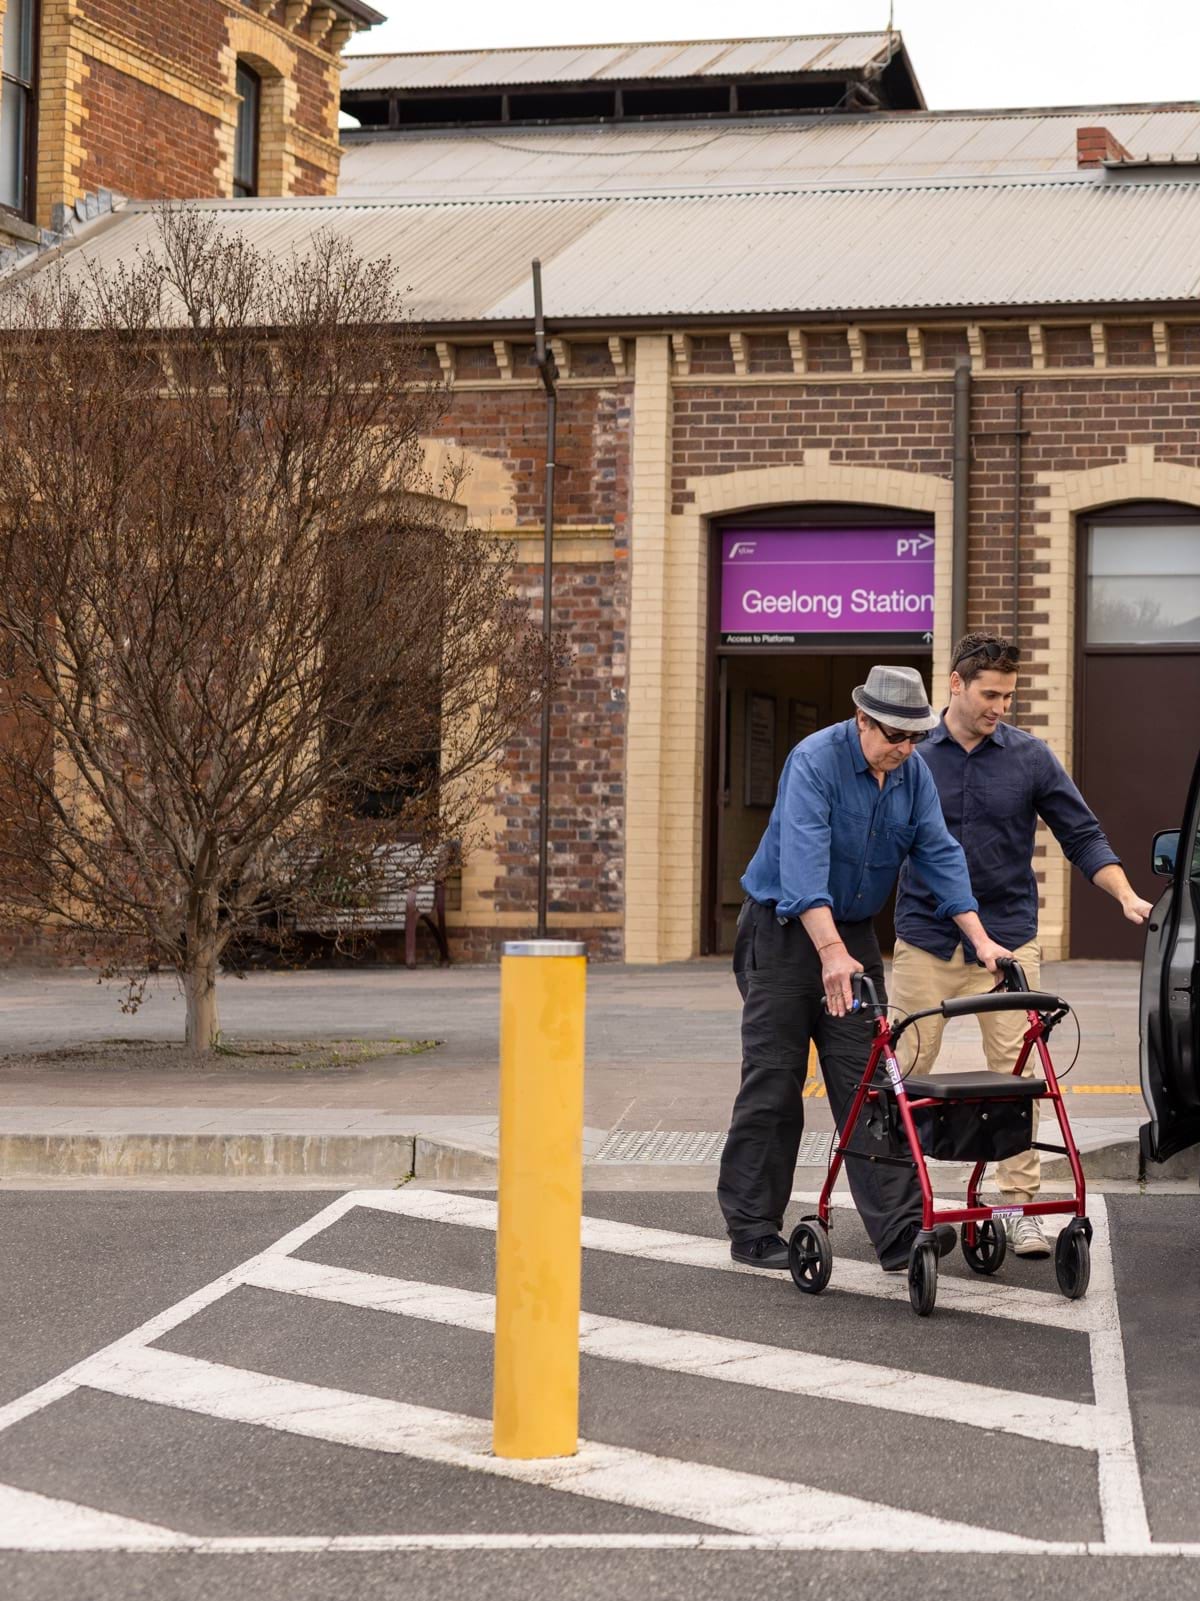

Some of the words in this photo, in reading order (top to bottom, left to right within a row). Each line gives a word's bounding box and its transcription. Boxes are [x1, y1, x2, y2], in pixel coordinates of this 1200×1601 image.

[742, 589, 842, 618] Geelong
[850, 588, 934, 613] Station
[726, 634, 752, 643] Access
[753, 634, 761, 643] to
[762, 634, 795, 643] Platforms
